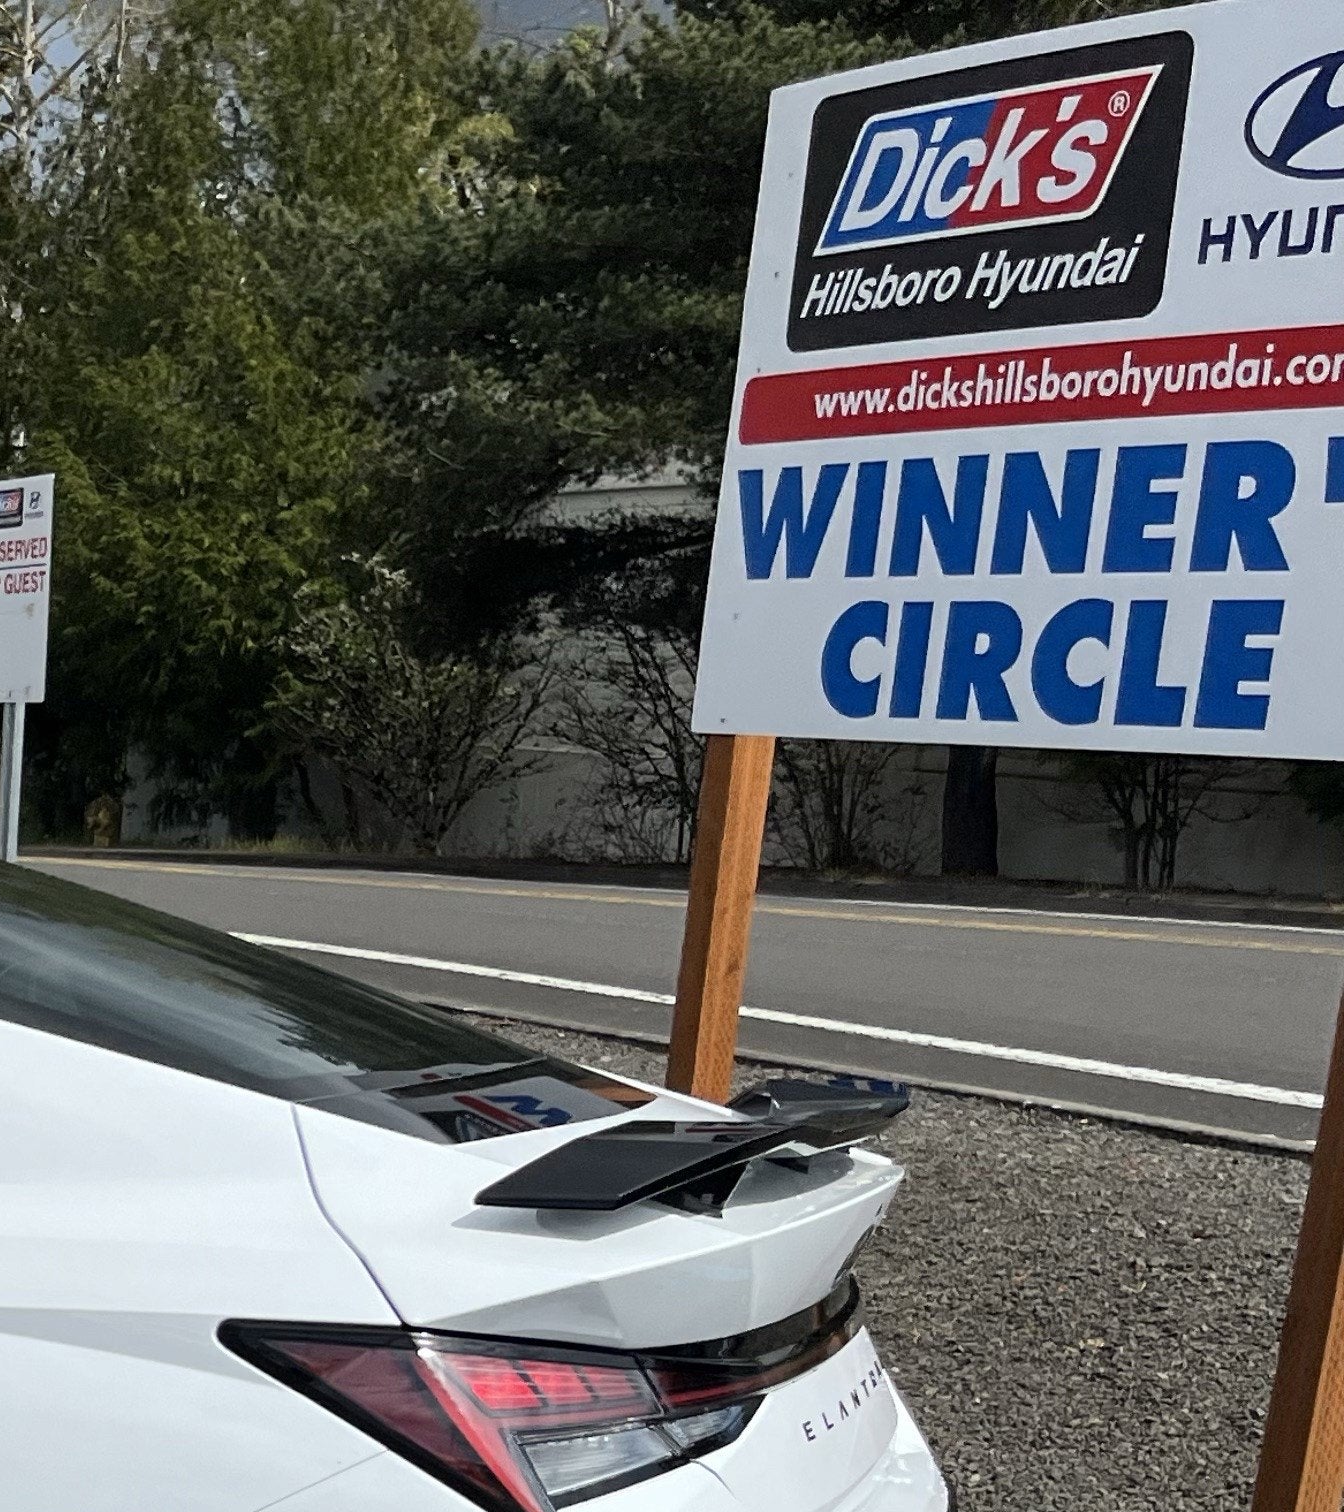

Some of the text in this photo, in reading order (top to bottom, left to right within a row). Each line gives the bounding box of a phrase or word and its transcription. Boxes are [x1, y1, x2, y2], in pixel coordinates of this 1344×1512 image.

[800, 234, 1145, 318] Hillsboro Hyundai
[4, 571, 47, 594] GUEST
[820, 599, 1285, 731] CIRCLE
